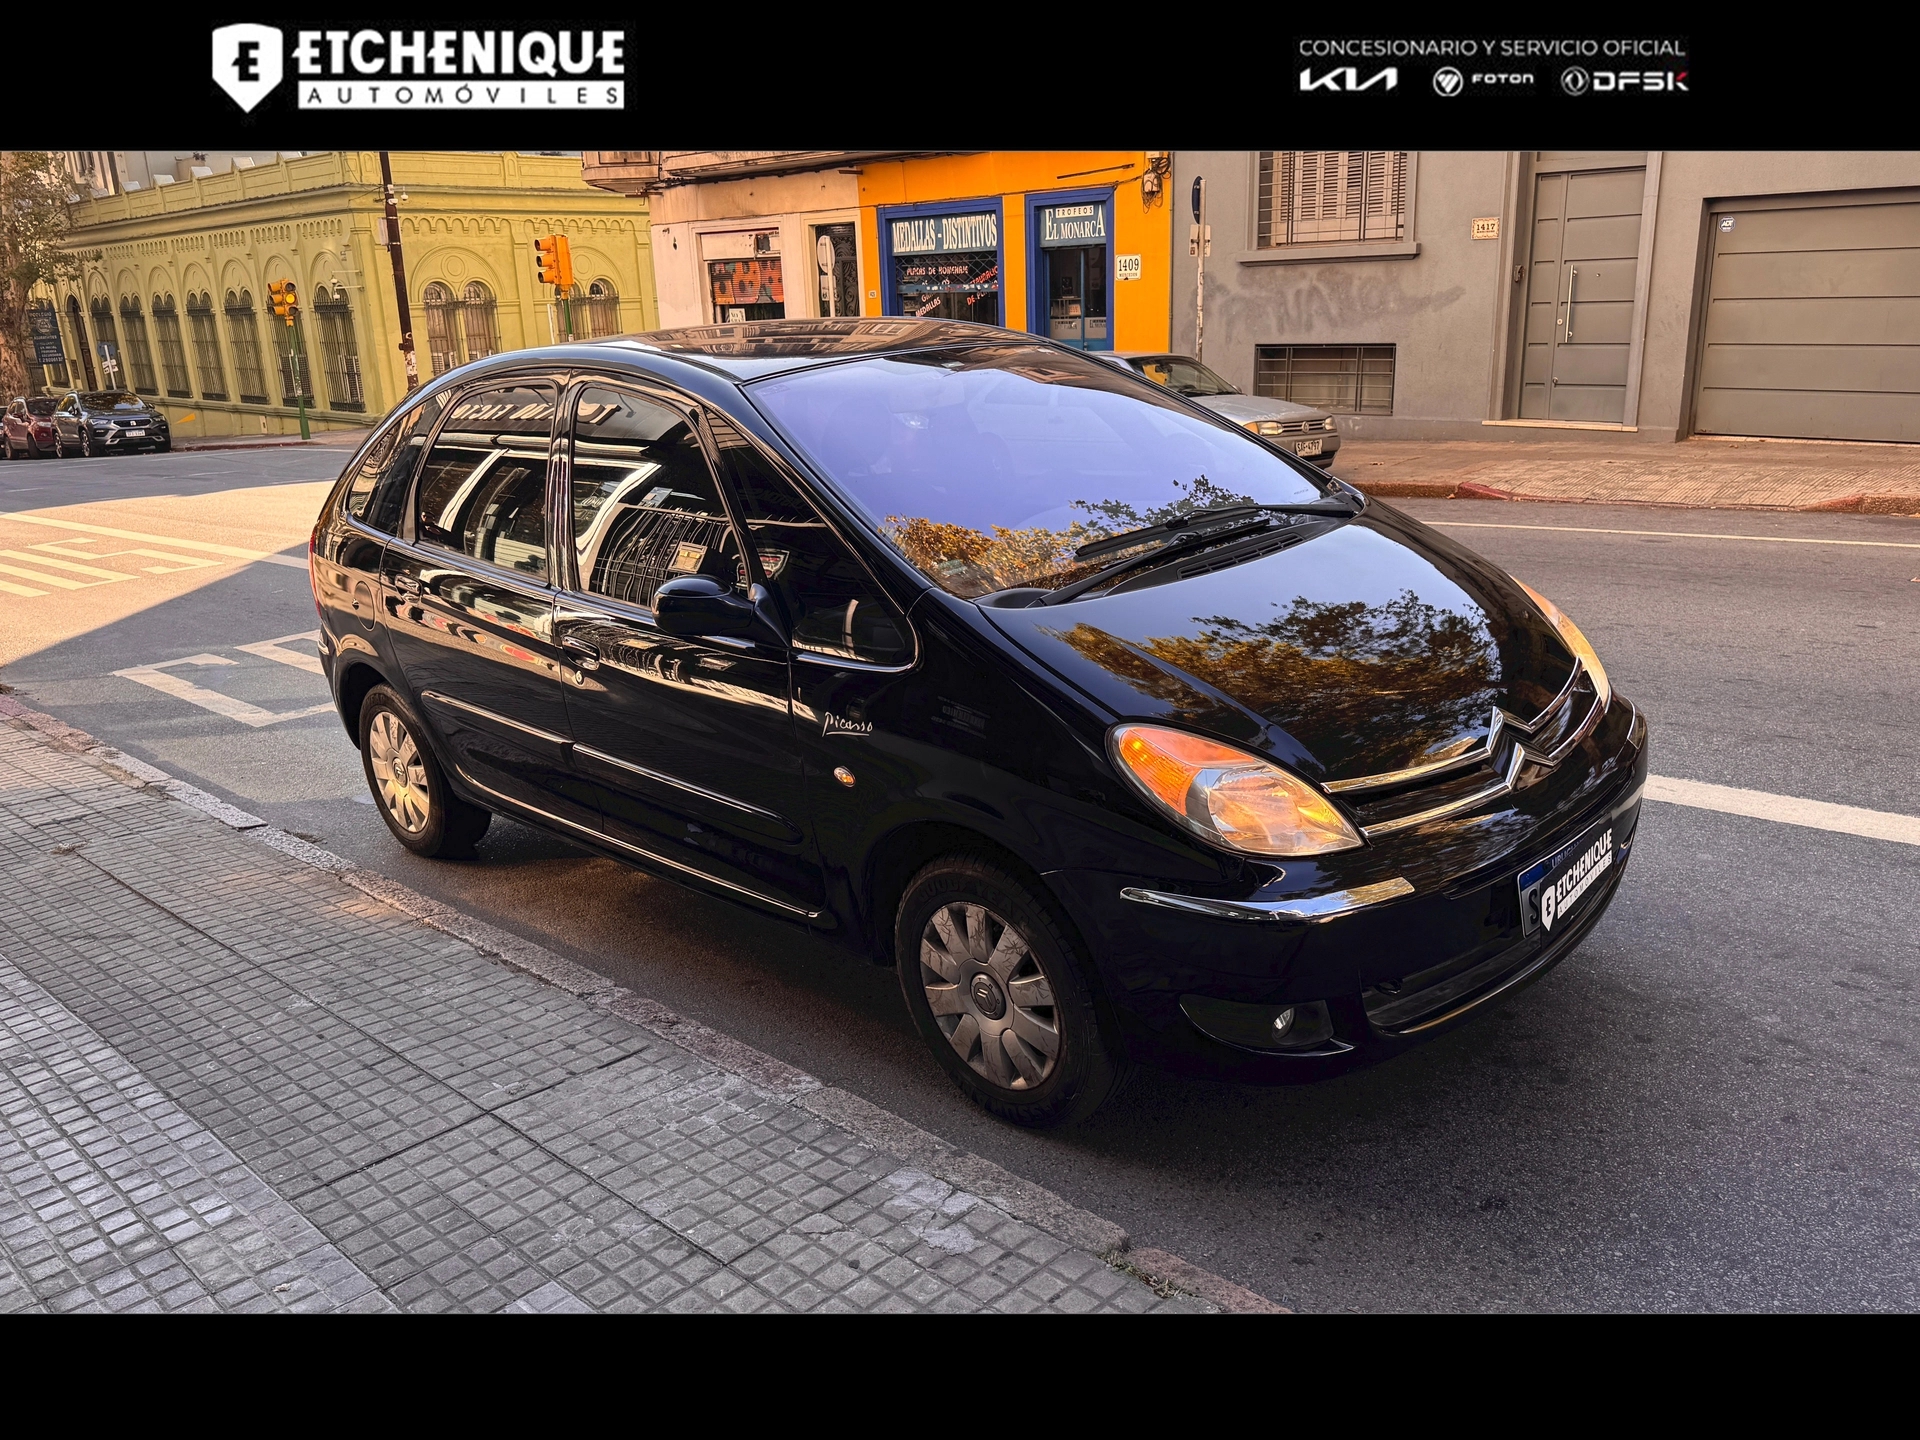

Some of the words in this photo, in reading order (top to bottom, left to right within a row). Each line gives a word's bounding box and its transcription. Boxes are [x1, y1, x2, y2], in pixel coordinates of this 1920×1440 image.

[1057, 207, 1093, 217] TROFEOS
[1060, 204, 1106, 239] MONARCA
[1476, 223, 1496, 231] 1417
[892, 218, 936, 253] MEDALLAS
[942, 213, 997, 250] DISTINTIVOS
[928, 267, 937, 275] DE
[1118, 258, 1140, 271] 1409
[821, 711, 873, 737] Picasso
